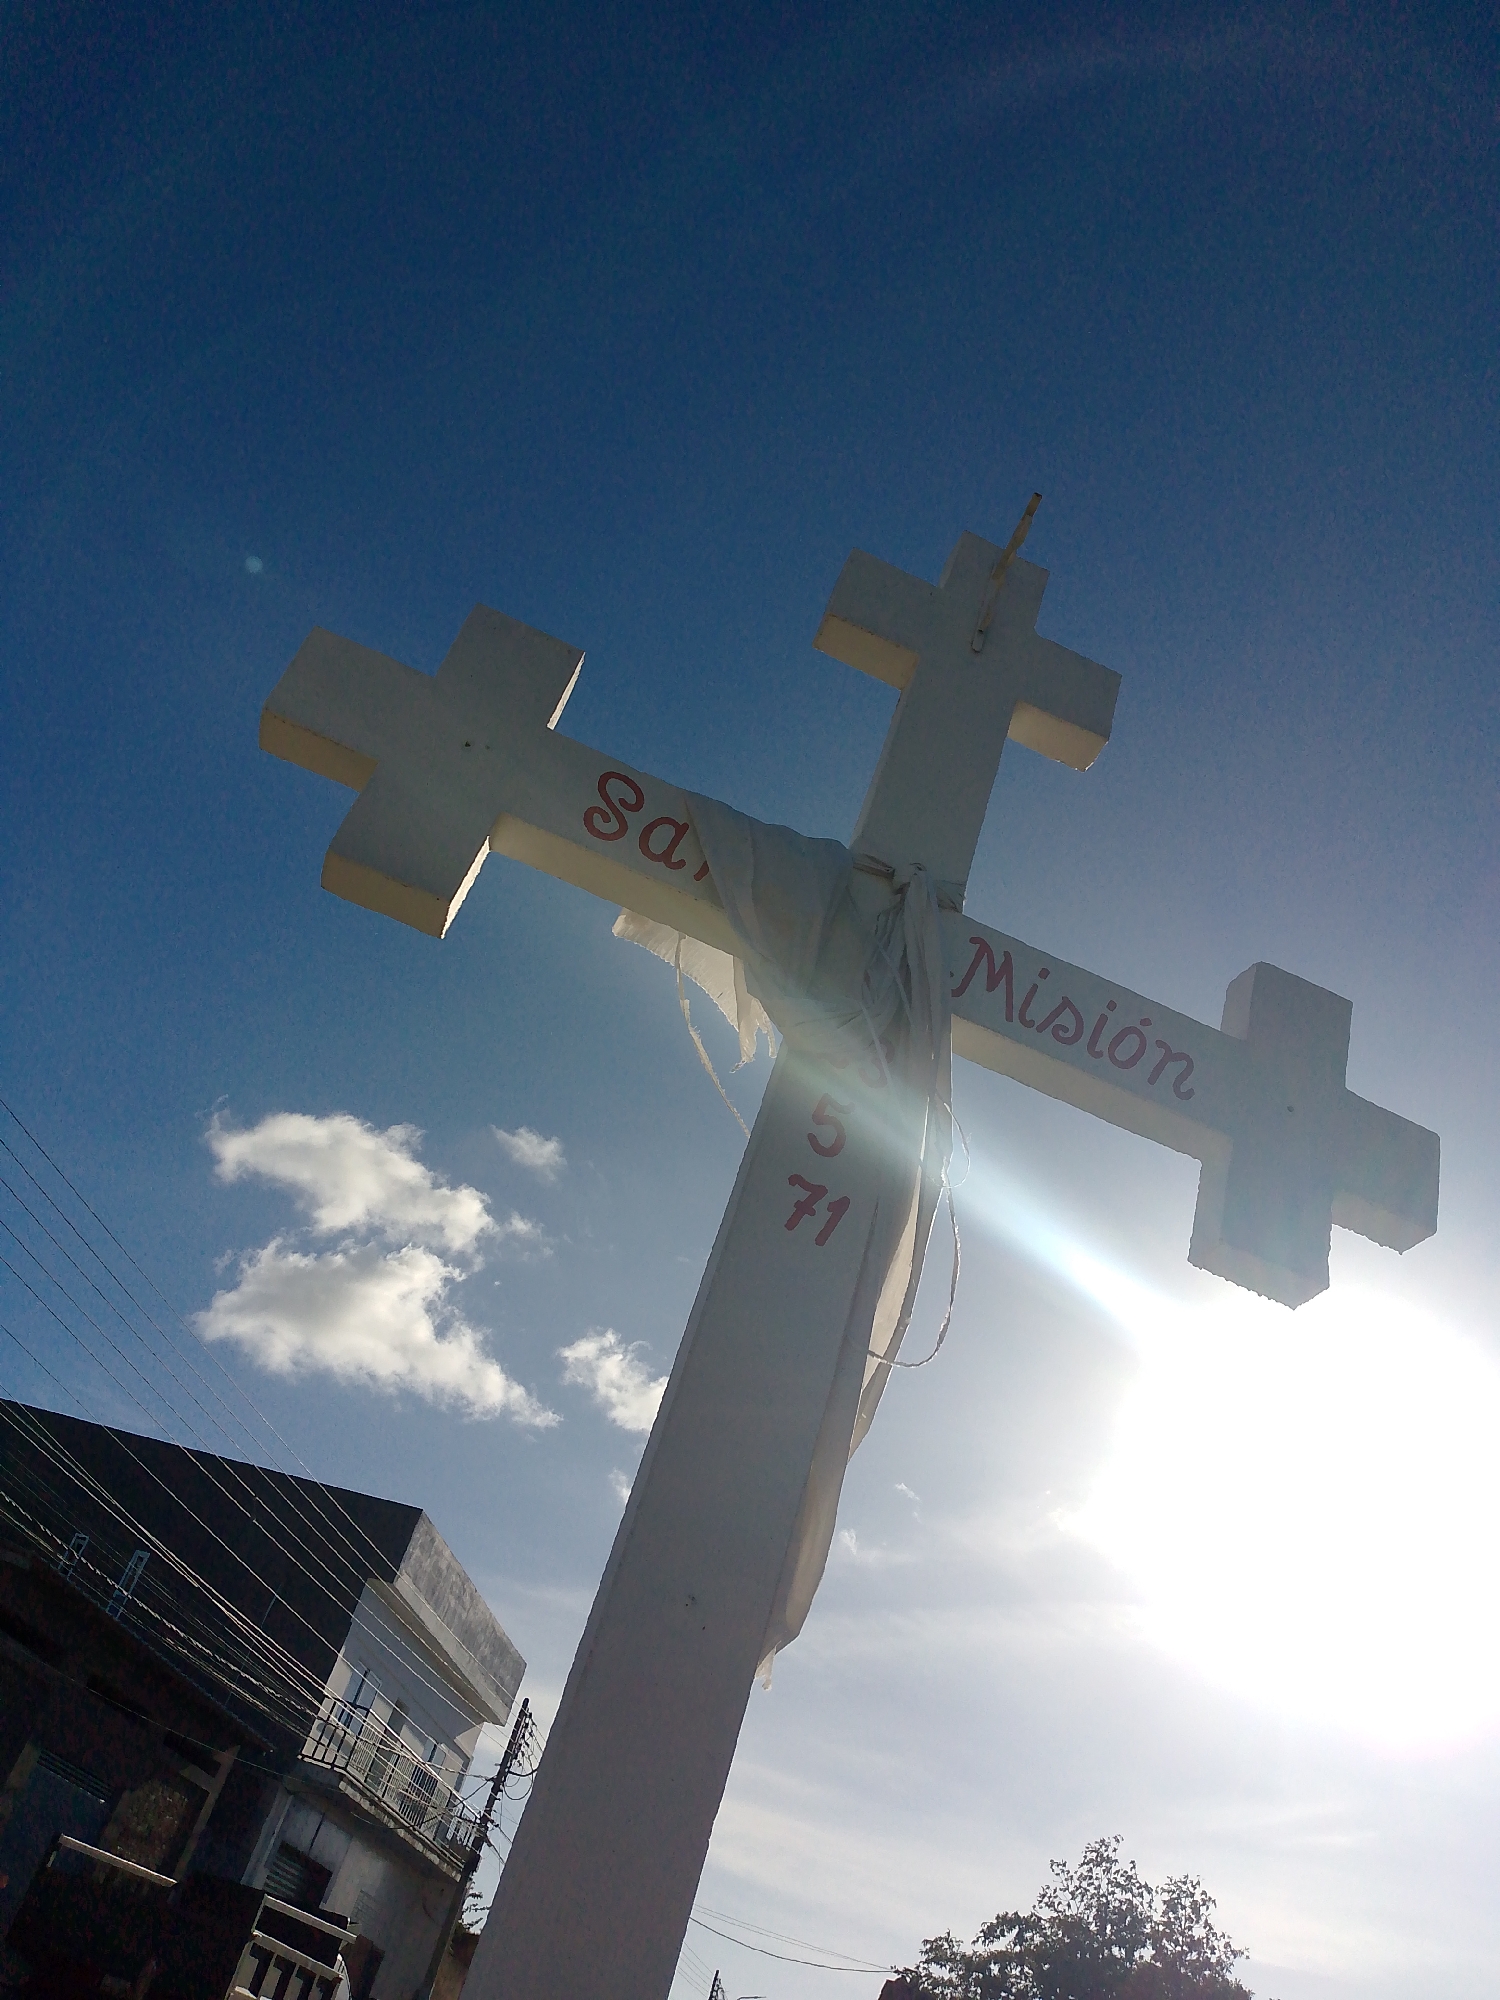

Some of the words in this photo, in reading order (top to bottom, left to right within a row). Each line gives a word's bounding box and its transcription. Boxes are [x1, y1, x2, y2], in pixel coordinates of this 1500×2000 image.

[584, 771, 710, 881] Sa
[951, 937, 1195, 1100] Misión
[808, 1092, 855, 1158] 5
[784, 1174, 851, 1247] 71
